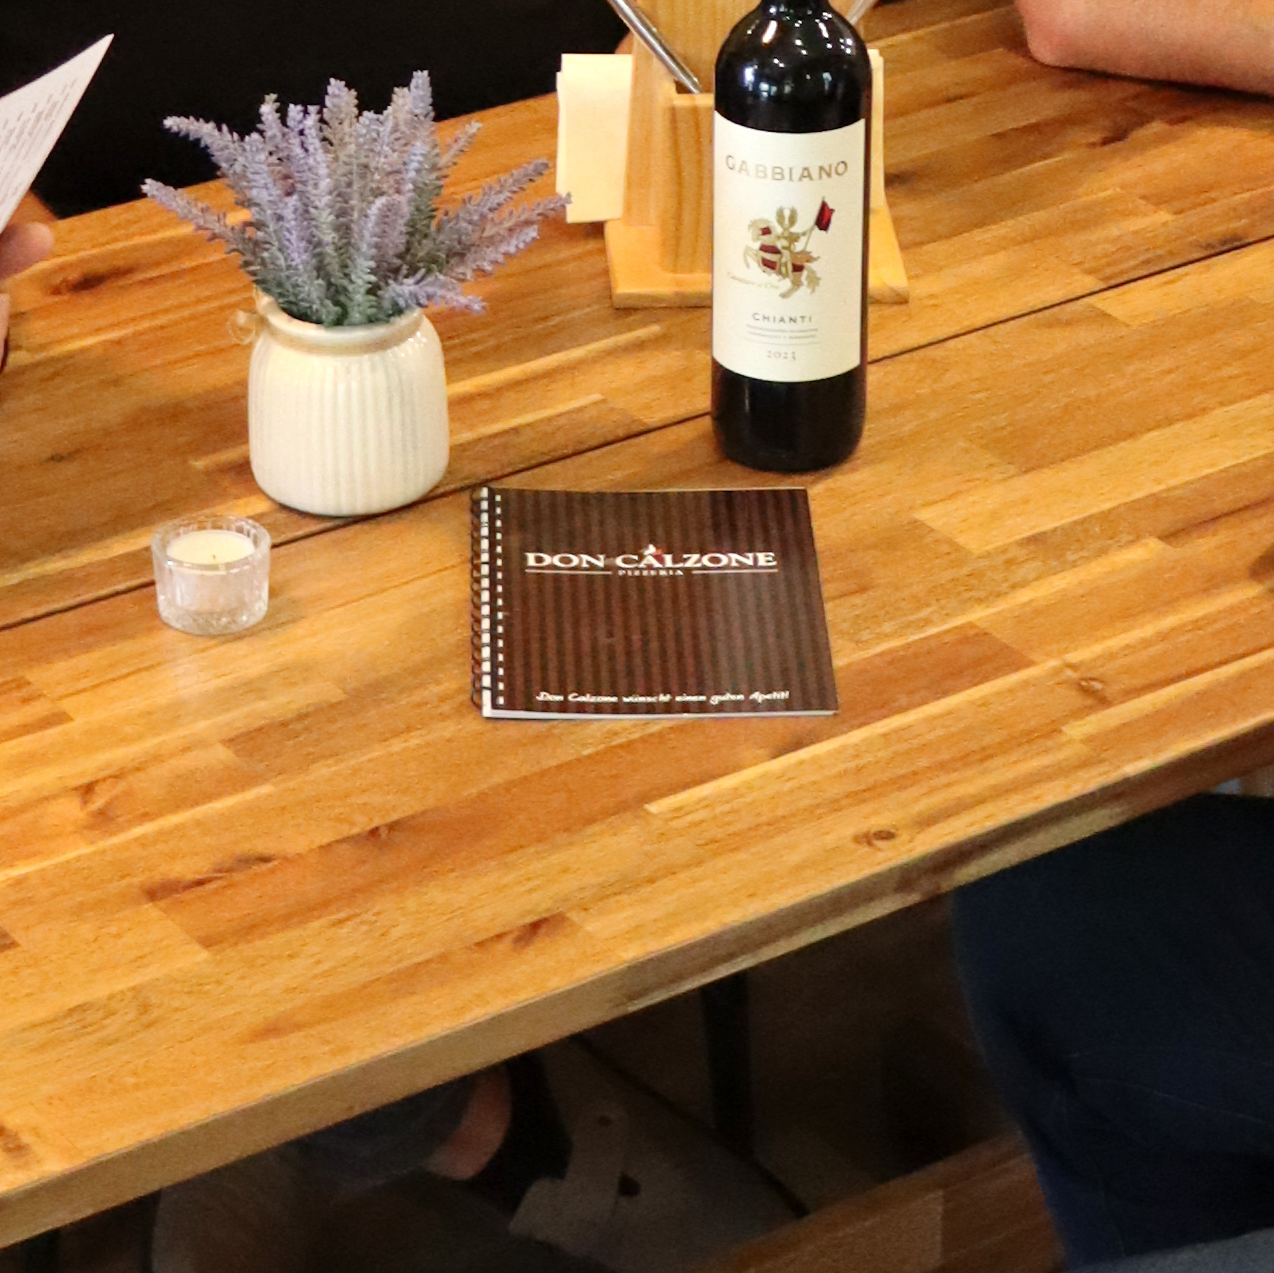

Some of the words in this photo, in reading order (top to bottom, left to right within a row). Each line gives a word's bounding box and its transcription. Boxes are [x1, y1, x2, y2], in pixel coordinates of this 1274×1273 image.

[725, 154, 849, 182] GABBIANO
[751, 312, 813, 324] CHIANTI
[524, 552, 607, 569] DON
[614, 552, 778, 569] CALZONE
[535, 691, 565, 703] Don
[567, 692, 619, 703] Calzone
